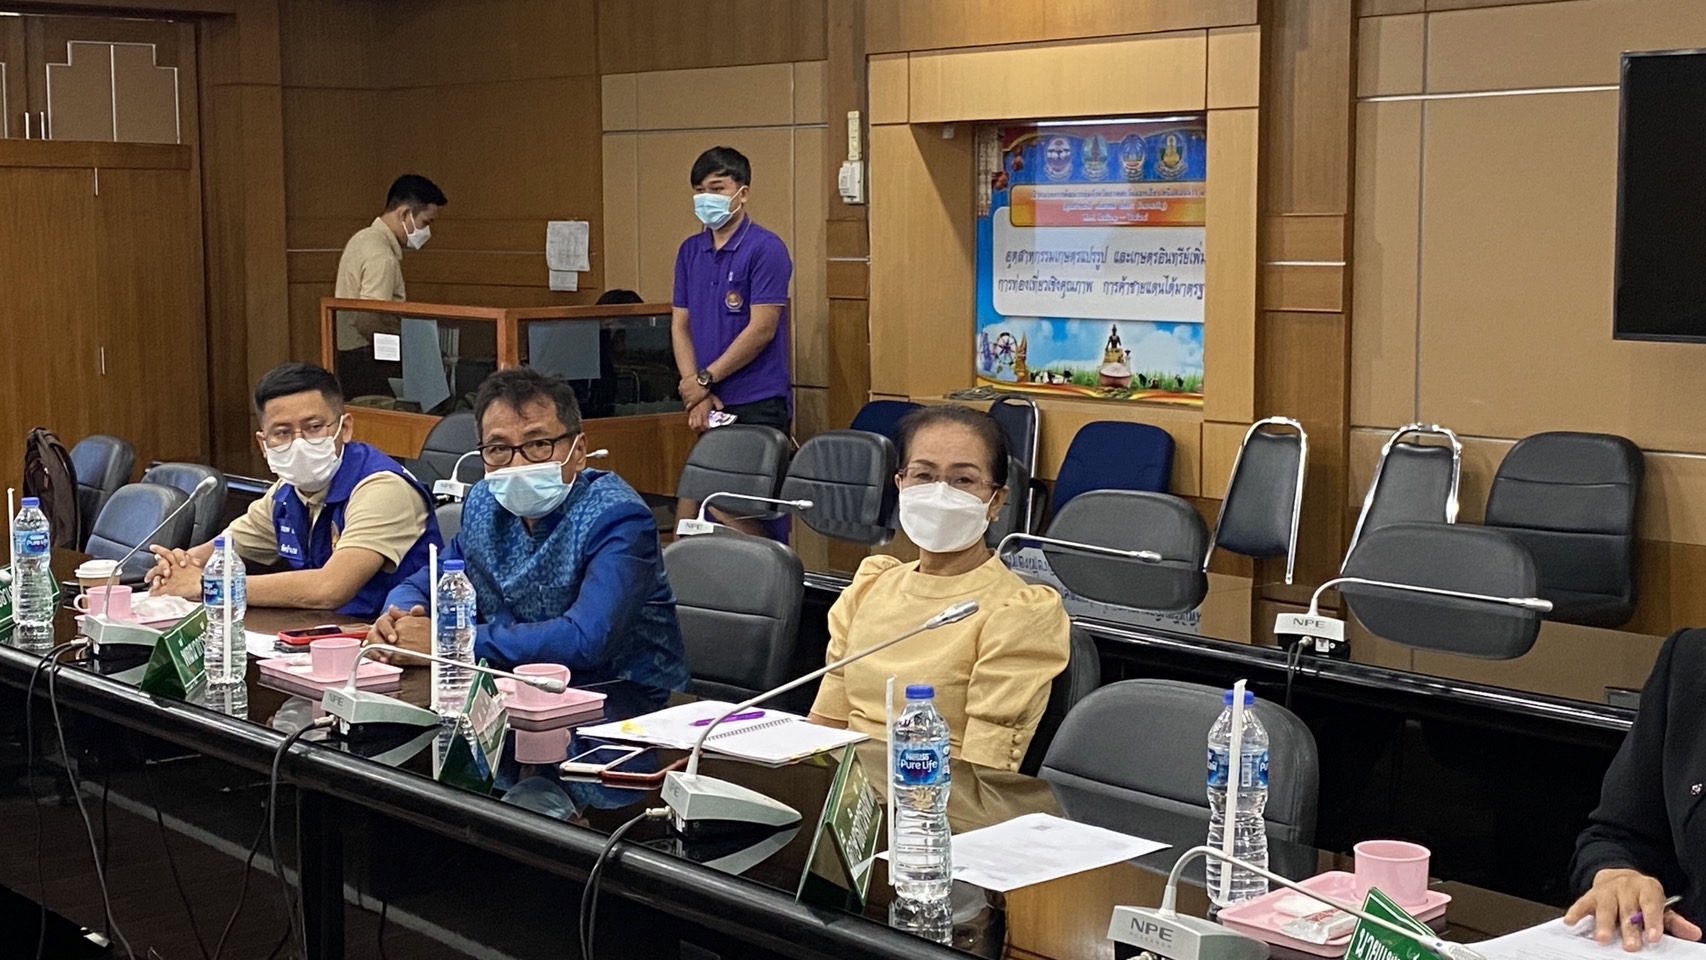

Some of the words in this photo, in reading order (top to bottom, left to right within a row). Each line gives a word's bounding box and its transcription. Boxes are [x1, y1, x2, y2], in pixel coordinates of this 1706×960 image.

[998, 270, 1094, 299] การท่องเที่ยวเชิงคุณภาพ
[1293, 617, 1325, 628] NPE
[900, 759, 921, 770] Pure
[922, 759, 938, 773] Life
[1130, 917, 1174, 942] NPE
